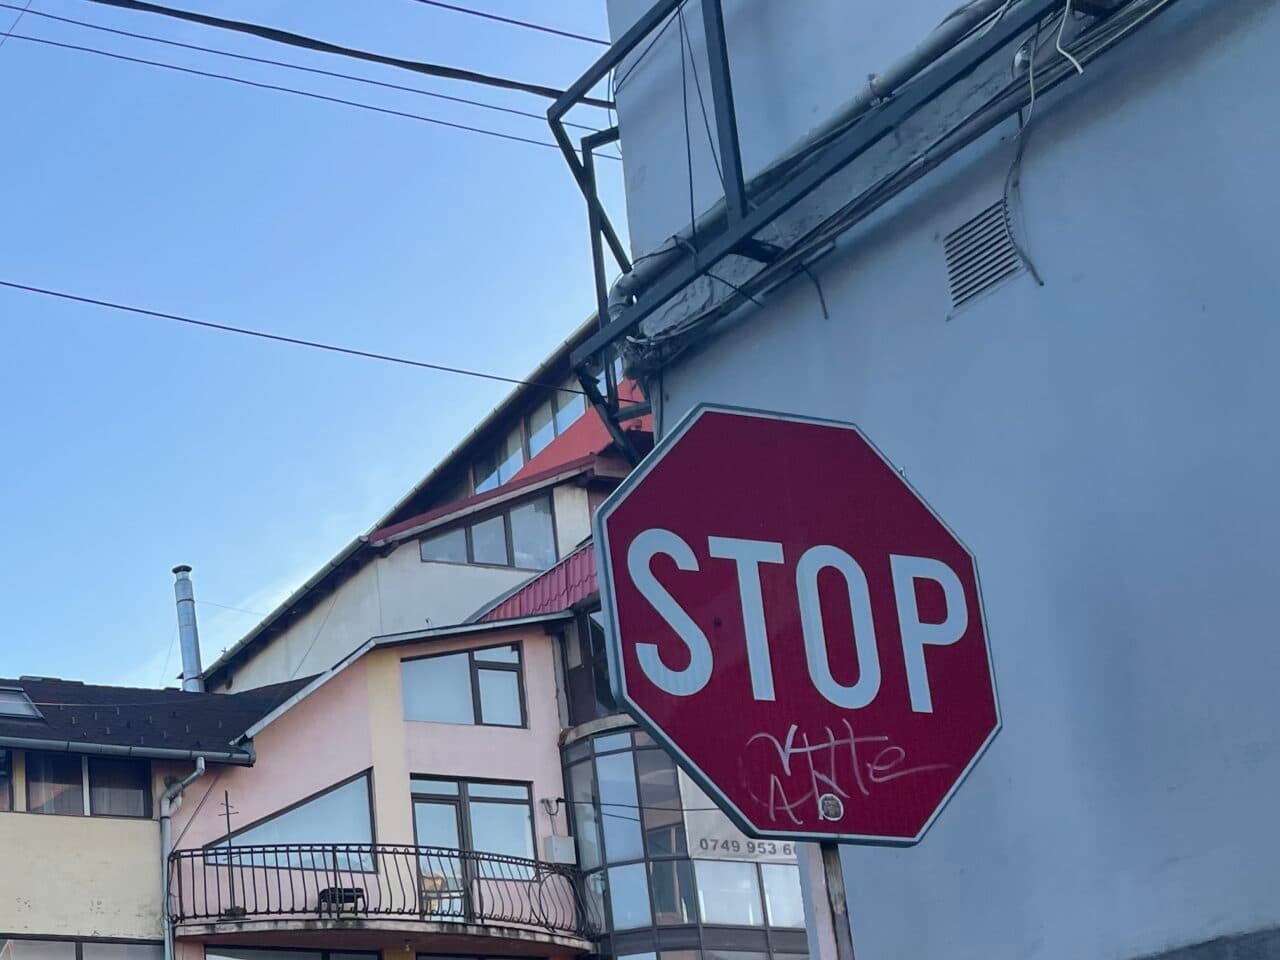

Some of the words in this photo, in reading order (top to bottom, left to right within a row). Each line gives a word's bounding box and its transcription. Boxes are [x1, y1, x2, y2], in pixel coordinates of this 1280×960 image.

[627, 528, 969, 714] STOP
[699, 838, 740, 852] 0749
[746, 841, 777, 855] 953
[783, 844, 797, 855] 6
